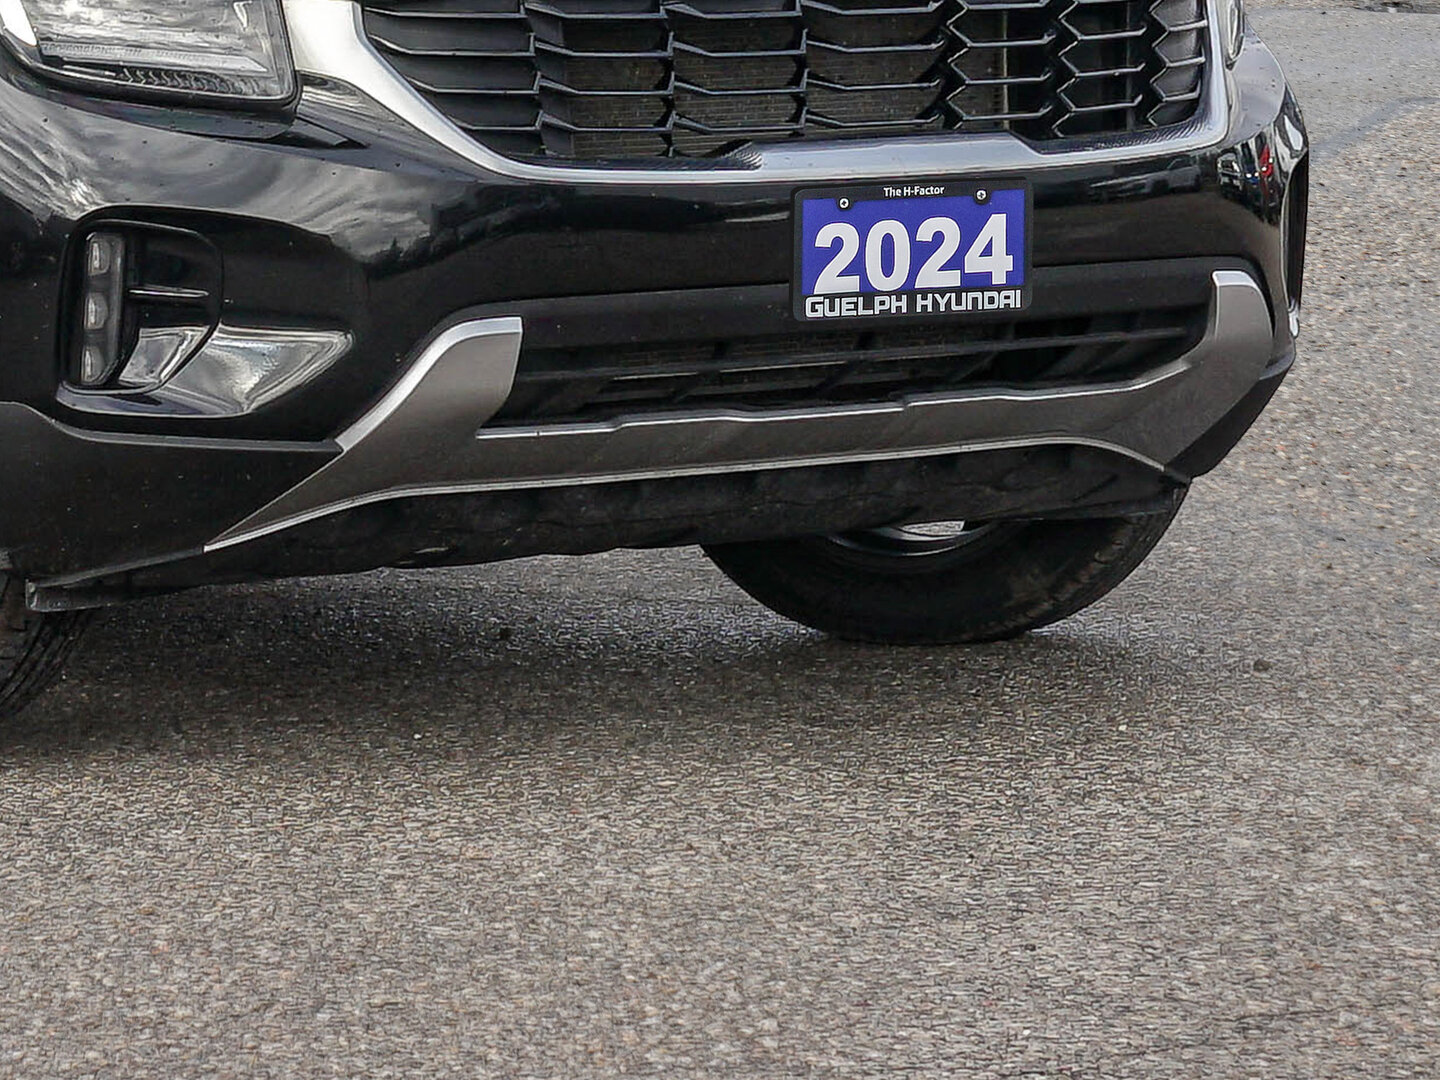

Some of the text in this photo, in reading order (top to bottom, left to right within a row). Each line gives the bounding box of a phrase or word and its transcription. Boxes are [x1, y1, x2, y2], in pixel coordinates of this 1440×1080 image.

[883, 185, 945, 198] The H-Factor
[813, 213, 1014, 295] 2024
[805, 289, 1022, 318] GUELPH HYUNDAI
